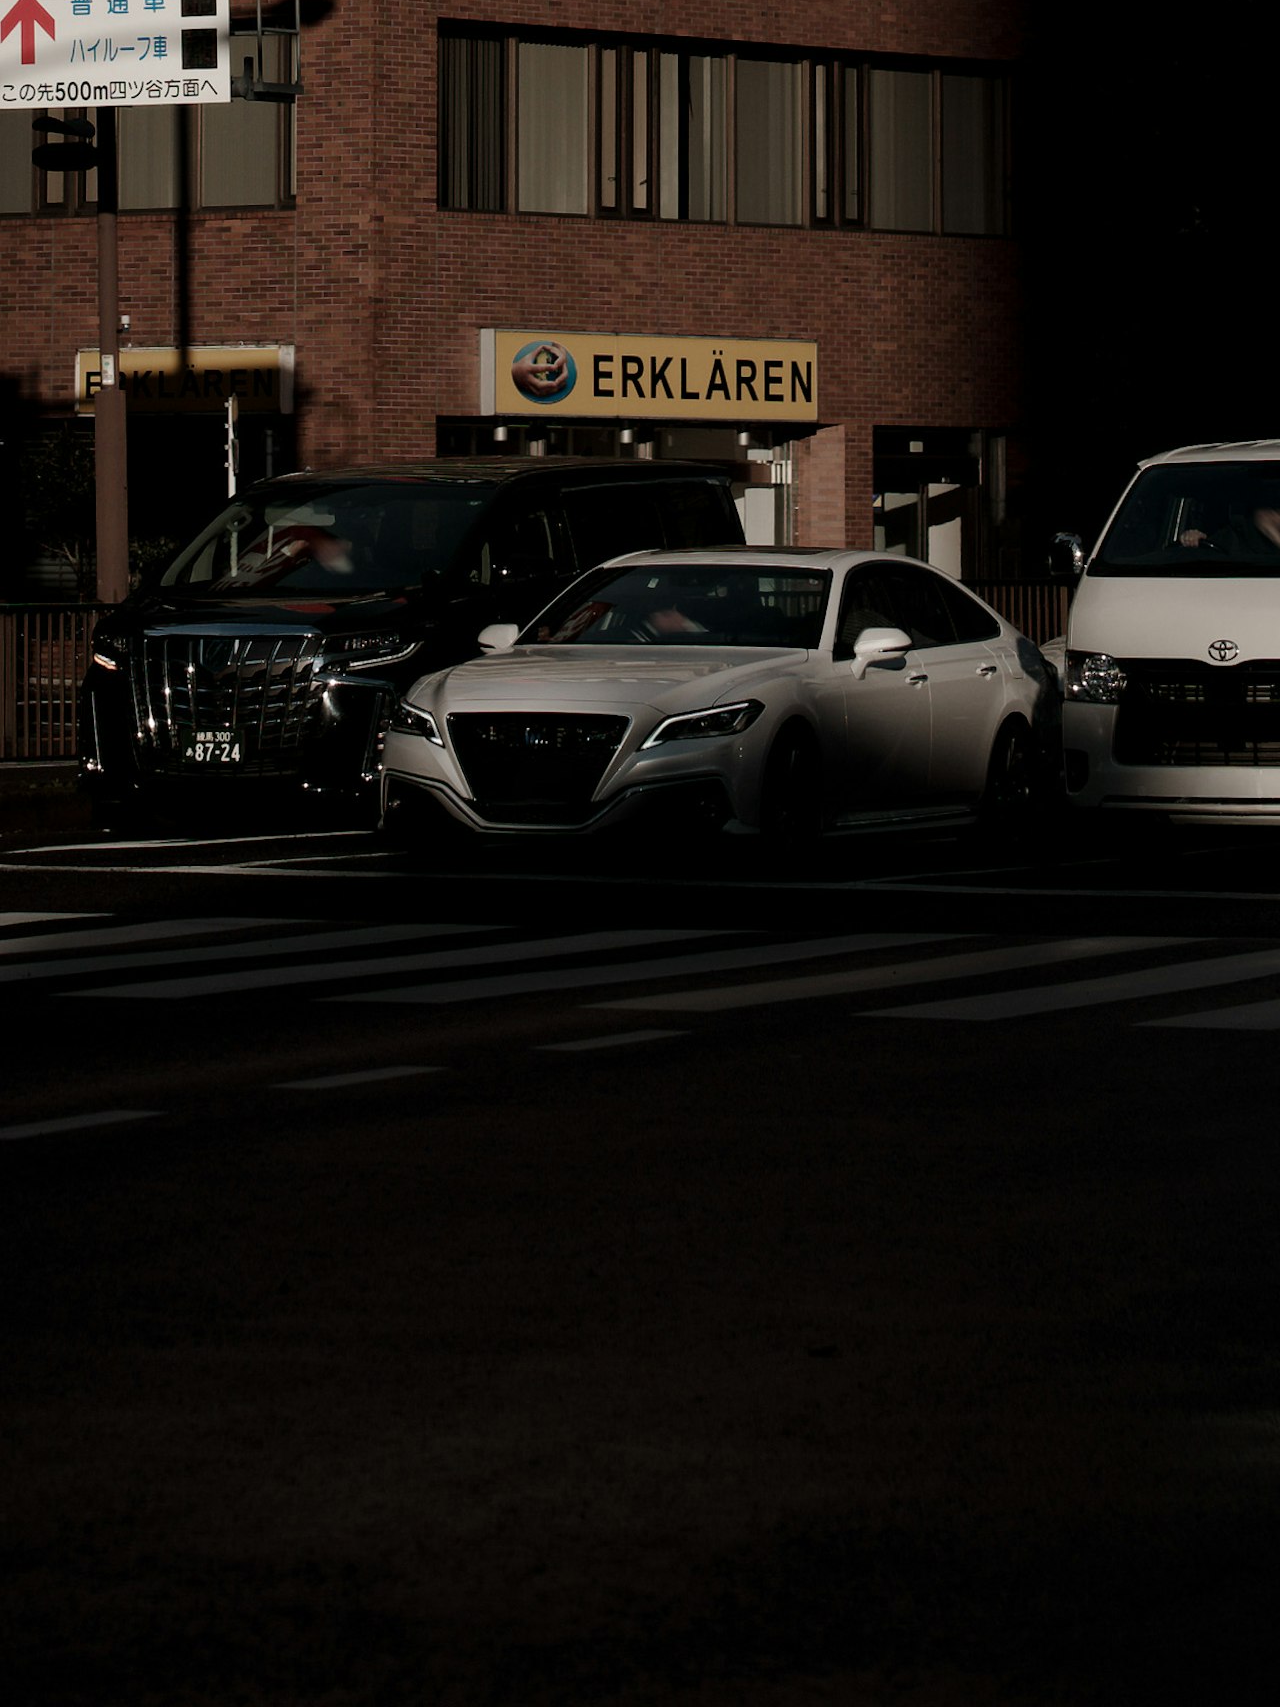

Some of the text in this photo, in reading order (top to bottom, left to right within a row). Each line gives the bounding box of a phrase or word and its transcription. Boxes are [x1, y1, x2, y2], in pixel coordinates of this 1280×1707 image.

[69, 34, 168, 64] ハイルーフ車
[593, 349, 813, 403] ERKLÄREN
[194, 742, 241, 763] 87-24
